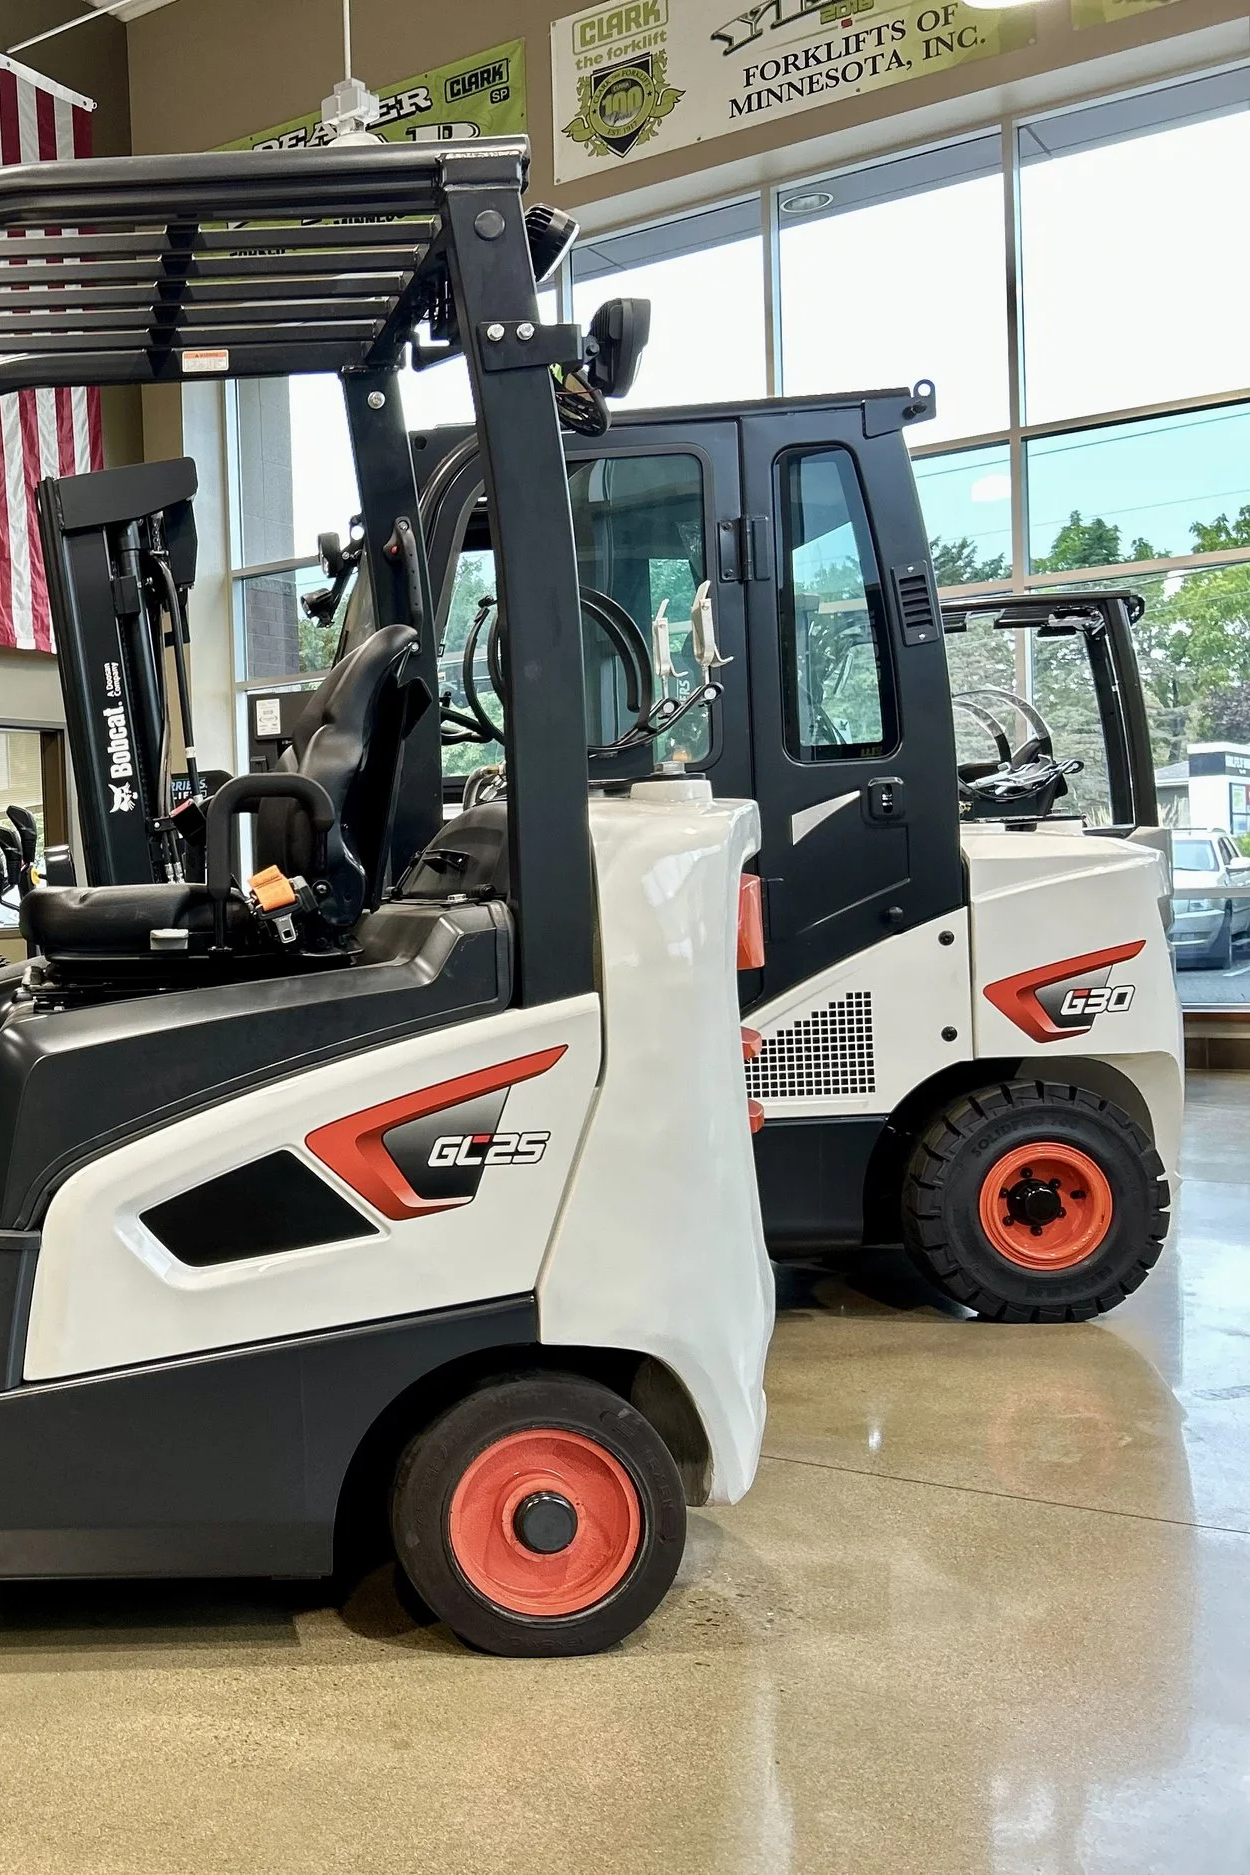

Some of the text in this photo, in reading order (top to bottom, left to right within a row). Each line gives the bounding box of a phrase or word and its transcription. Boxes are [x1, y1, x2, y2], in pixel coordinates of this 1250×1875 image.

[580, 0, 660, 48] CLARK
[575, 30, 668, 71] the forklift
[743, 20, 907, 88] FORKLIFTS
[916, 3, 959, 32] OF
[450, 63, 504, 98] CLARK
[728, 49, 913, 119] MINNESOTA,
[922, 26, 986, 61] INC.
[492, 88, 508, 102] SP
[103, 662, 114, 691] Doosan
[111, 661, 122, 697] Company
[1060, 984, 1136, 1016] G30
